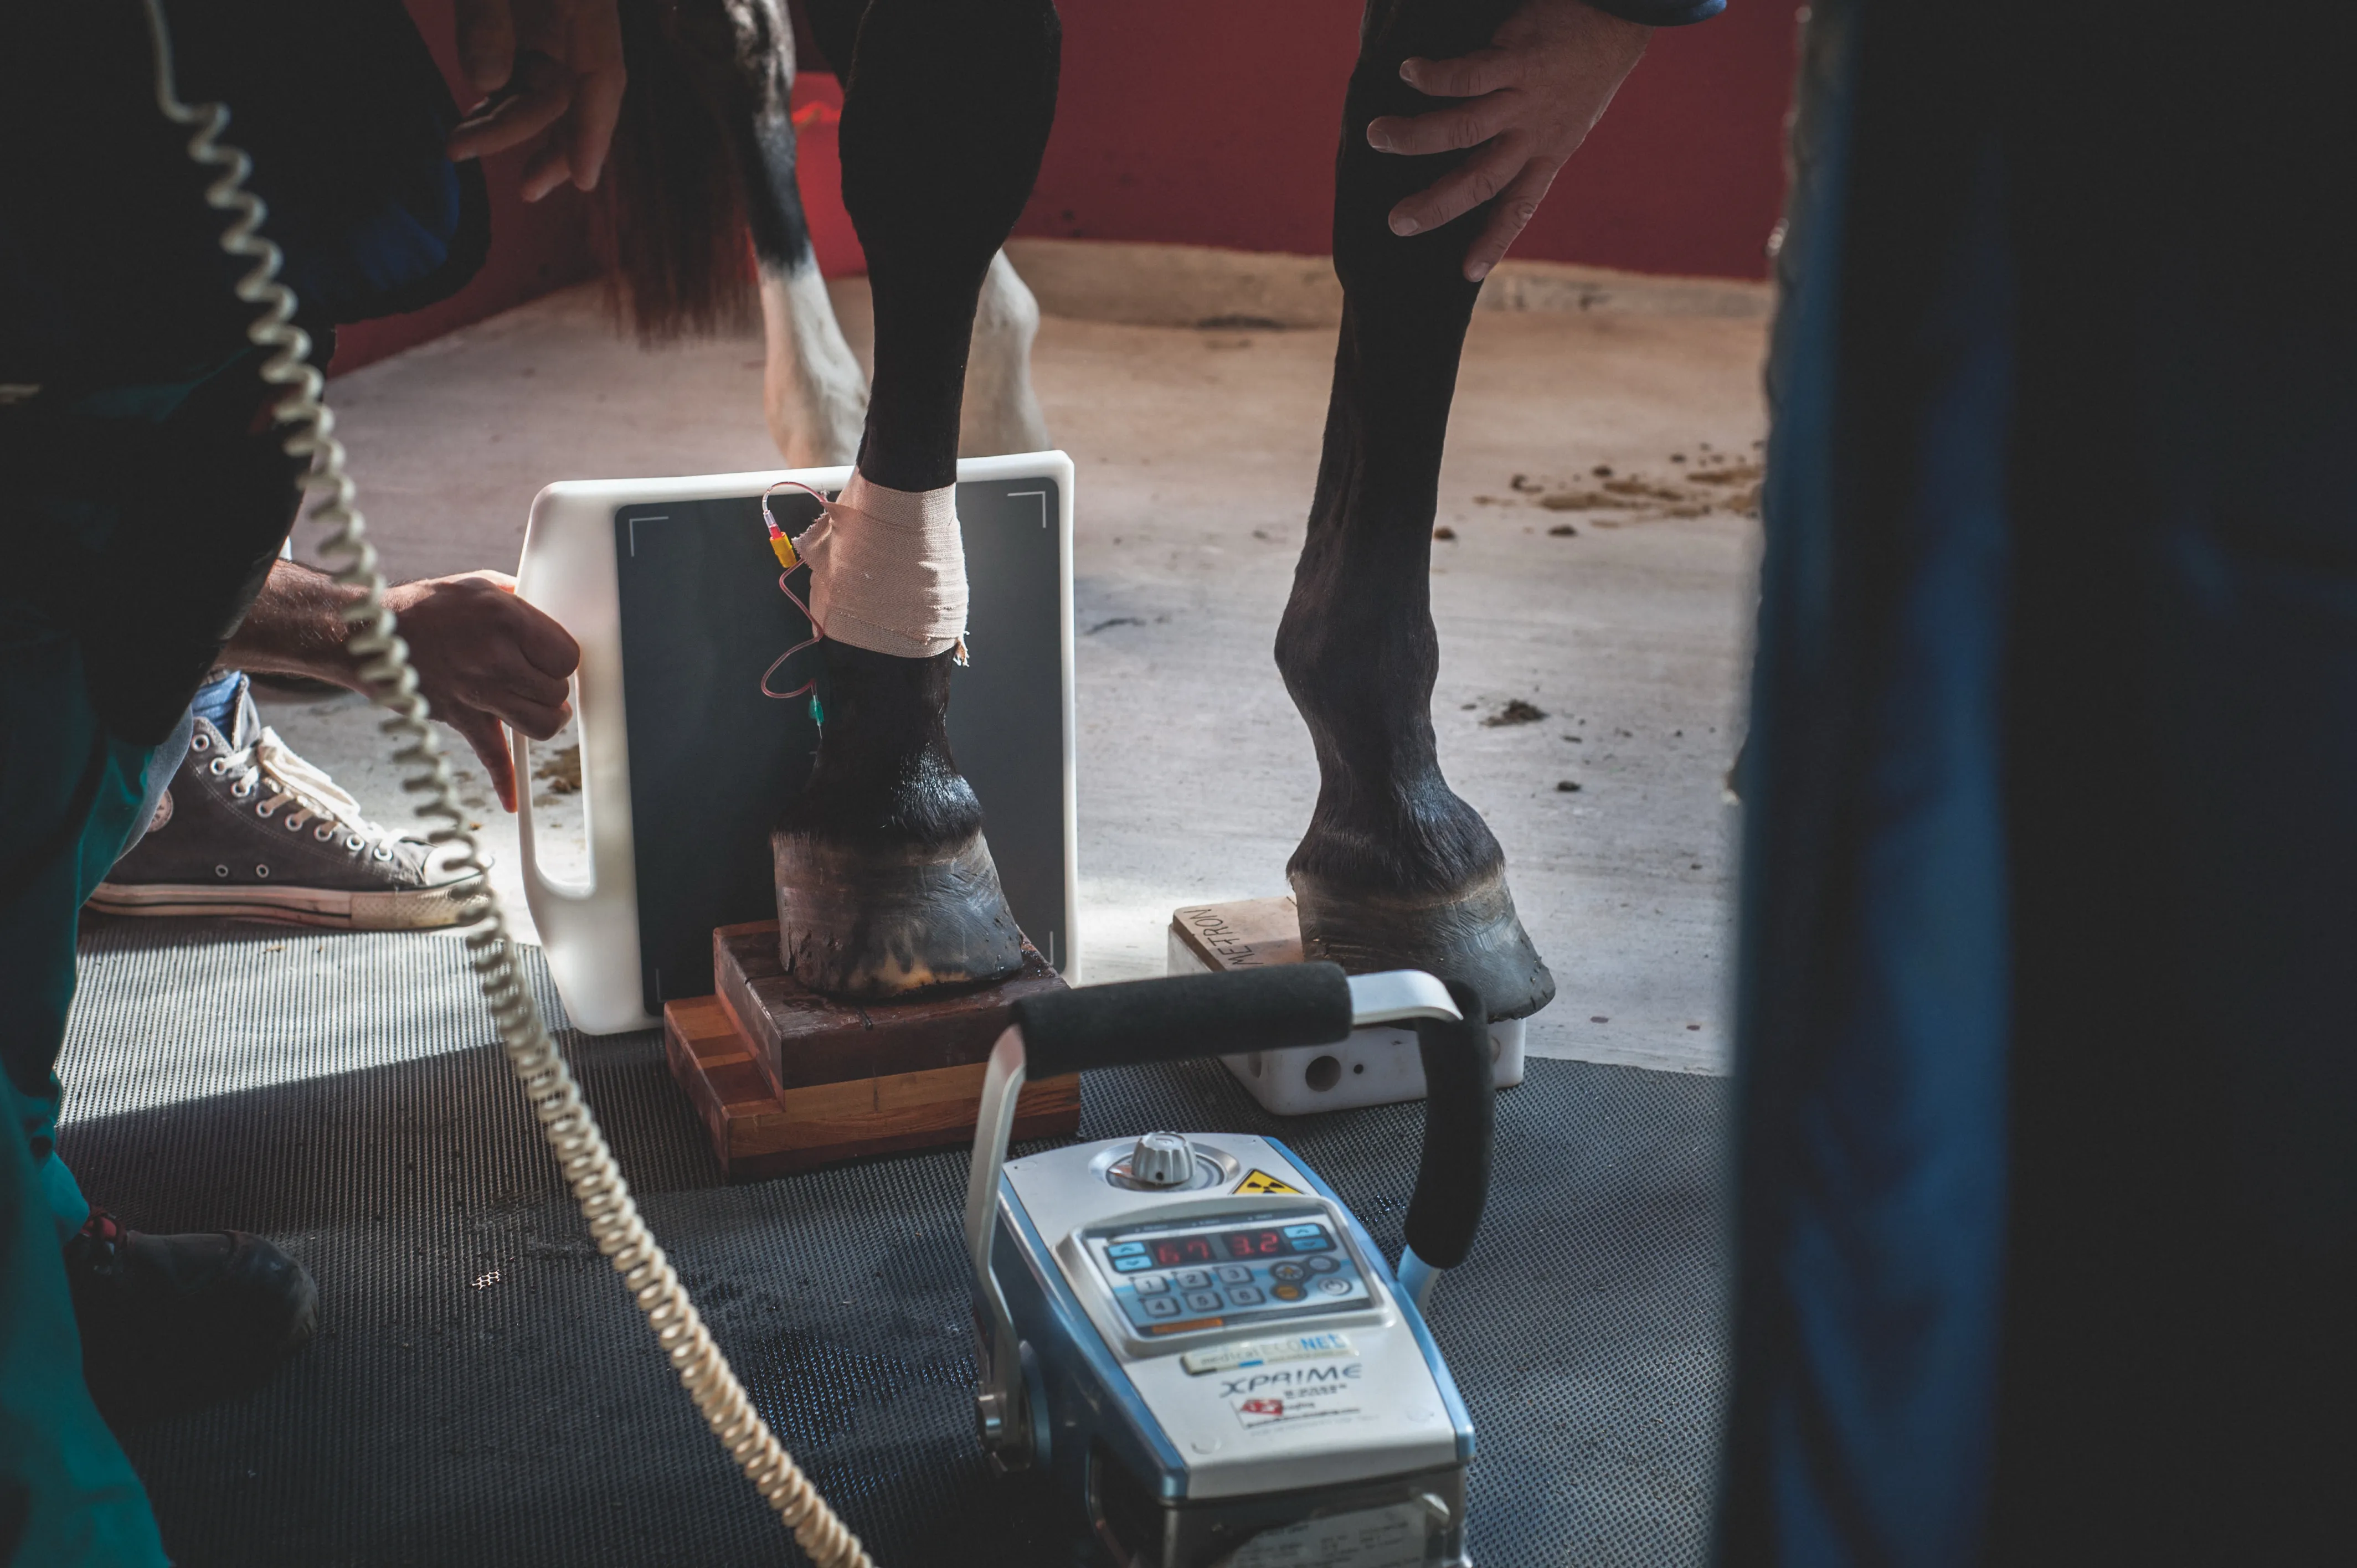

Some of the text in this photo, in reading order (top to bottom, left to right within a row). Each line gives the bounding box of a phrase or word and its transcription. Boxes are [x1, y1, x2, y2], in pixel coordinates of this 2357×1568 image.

[1183, 909, 1264, 965] METRON
[1157, 1240, 1210, 1266] 67
[1186, 1273, 1197, 1285] 2
[1230, 1269, 1241, 1280] 3
[1145, 1280, 1153, 1290] 1
[1196, 1295, 1208, 1307] 5
[1238, 1291, 1251, 1301] 6
[1154, 1300, 1165, 1311] 4
[1219, 1363, 1362, 1399] XPRIME
